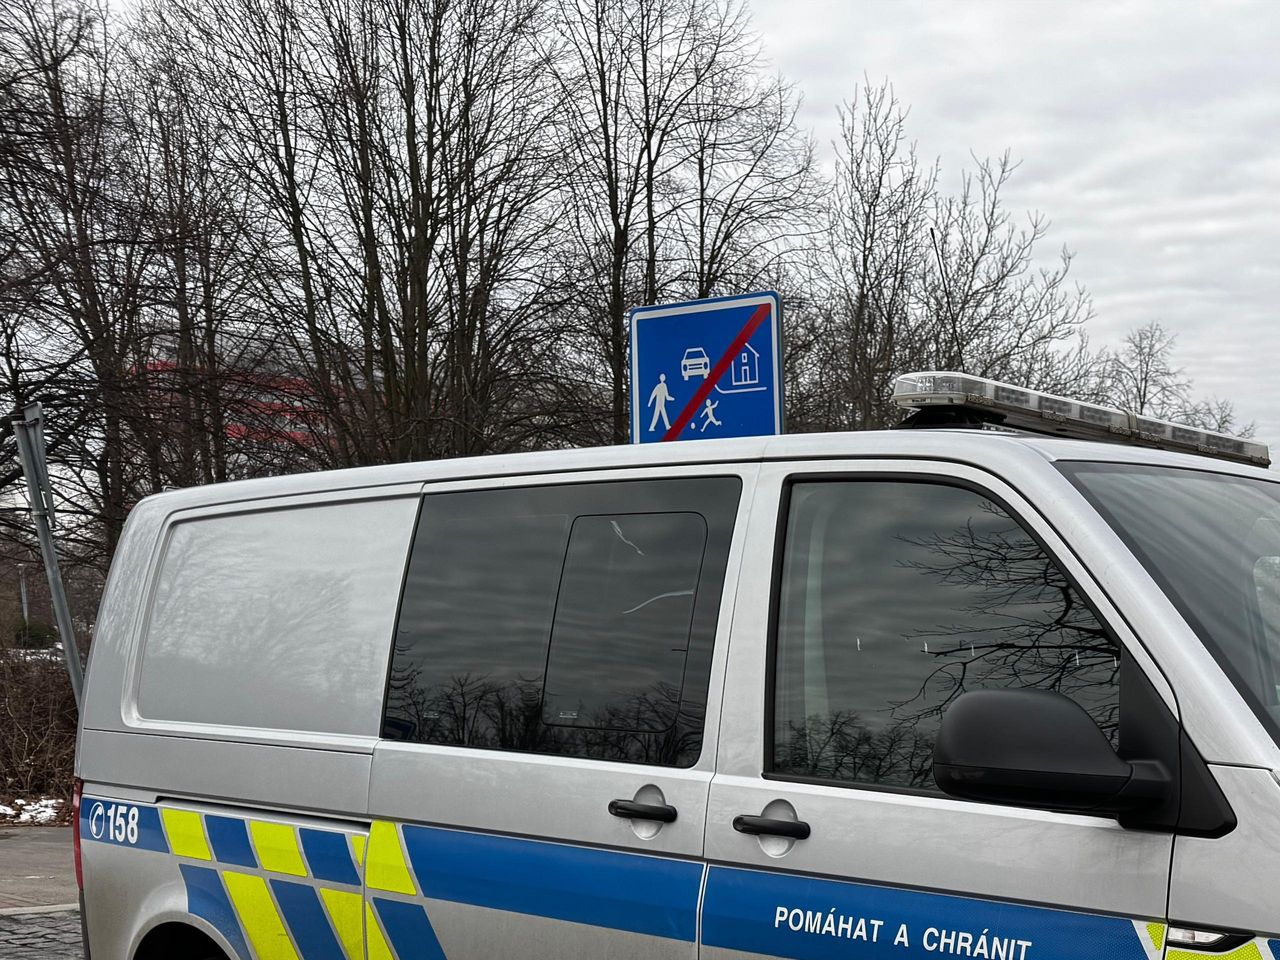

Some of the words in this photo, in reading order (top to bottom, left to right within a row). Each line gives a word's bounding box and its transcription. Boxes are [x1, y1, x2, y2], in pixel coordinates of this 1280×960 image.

[107, 804, 139, 844] 158
[774, 906, 884, 943] POMÁHAT
[894, 924, 909, 947] A
